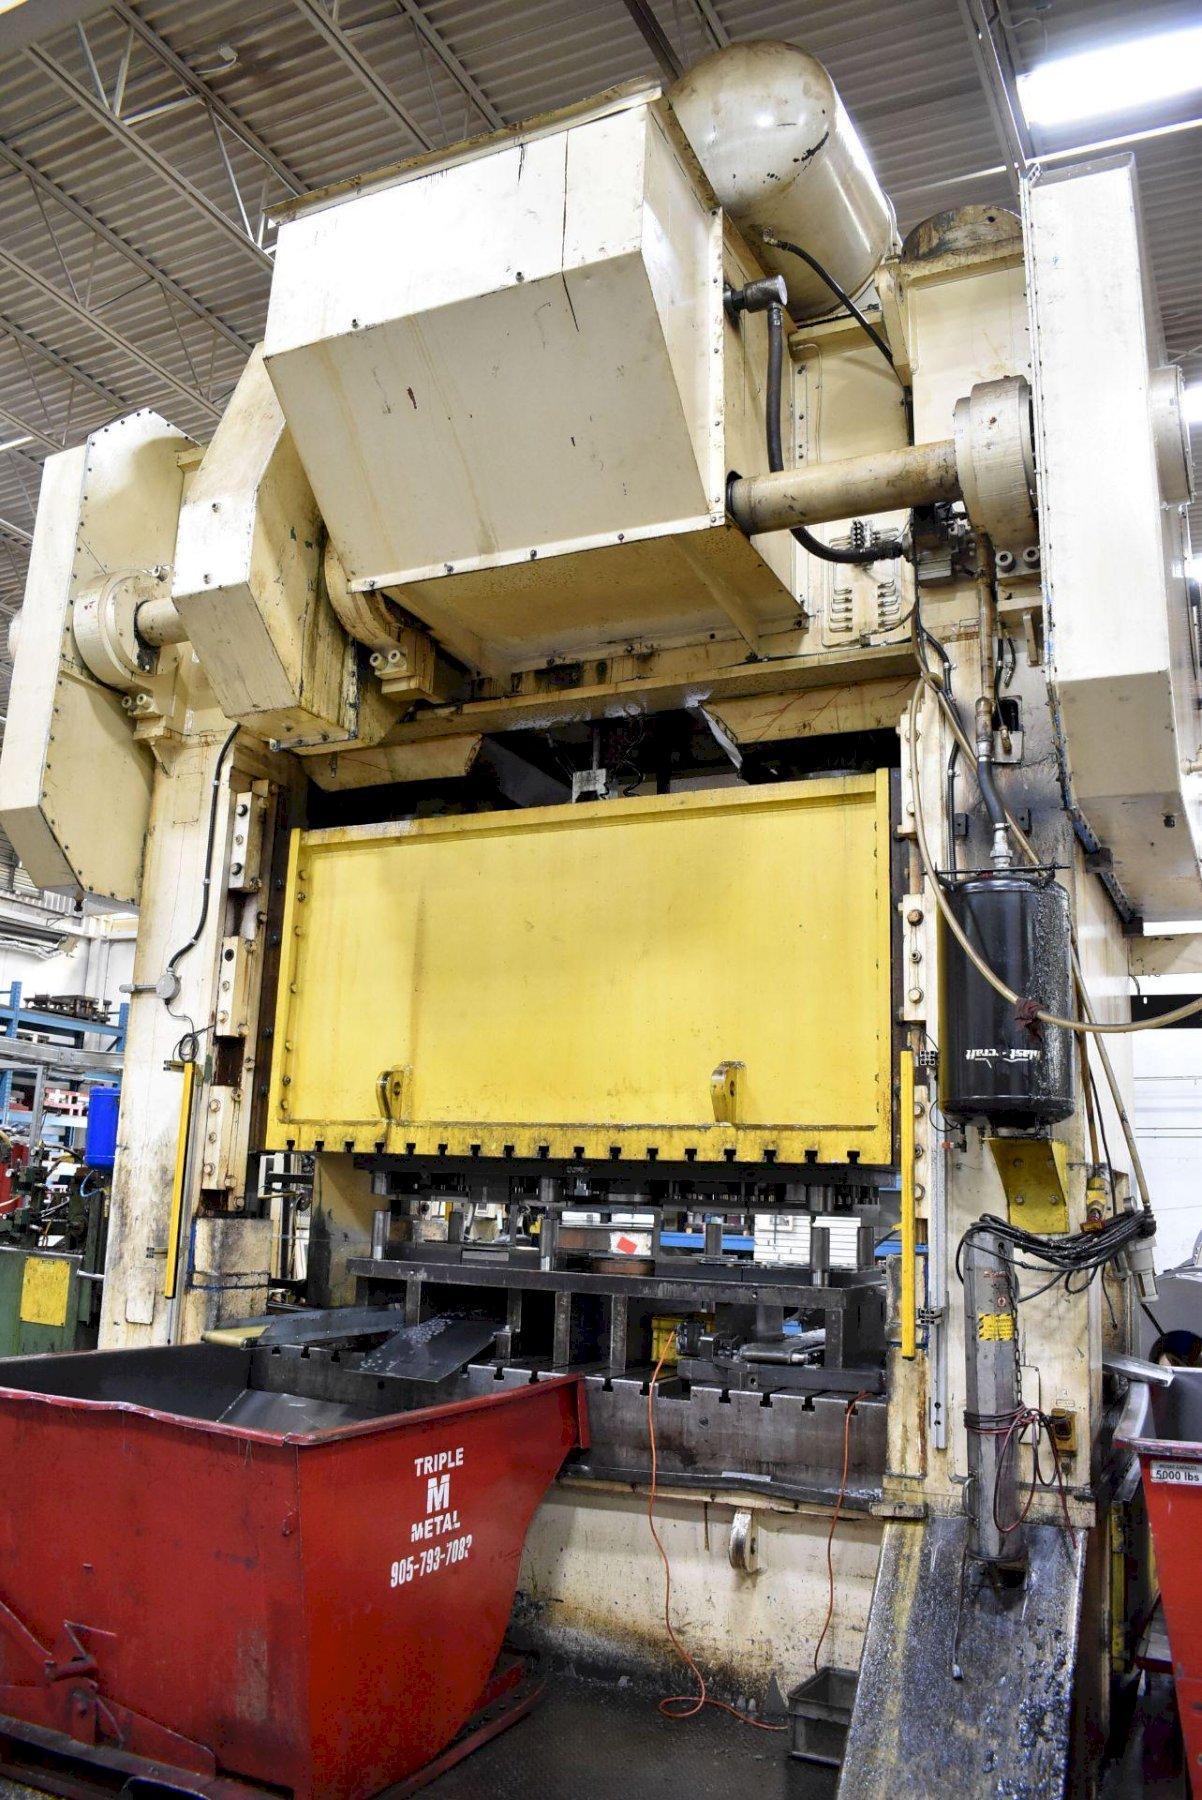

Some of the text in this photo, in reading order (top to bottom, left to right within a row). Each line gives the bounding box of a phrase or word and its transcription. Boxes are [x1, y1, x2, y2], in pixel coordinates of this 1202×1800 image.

[415, 1447, 464, 1477] TRIPLE
[1156, 1469, 1200, 1482] 5000 lbs
[426, 1474, 450, 1514] M
[411, 1510, 461, 1543] METAL
